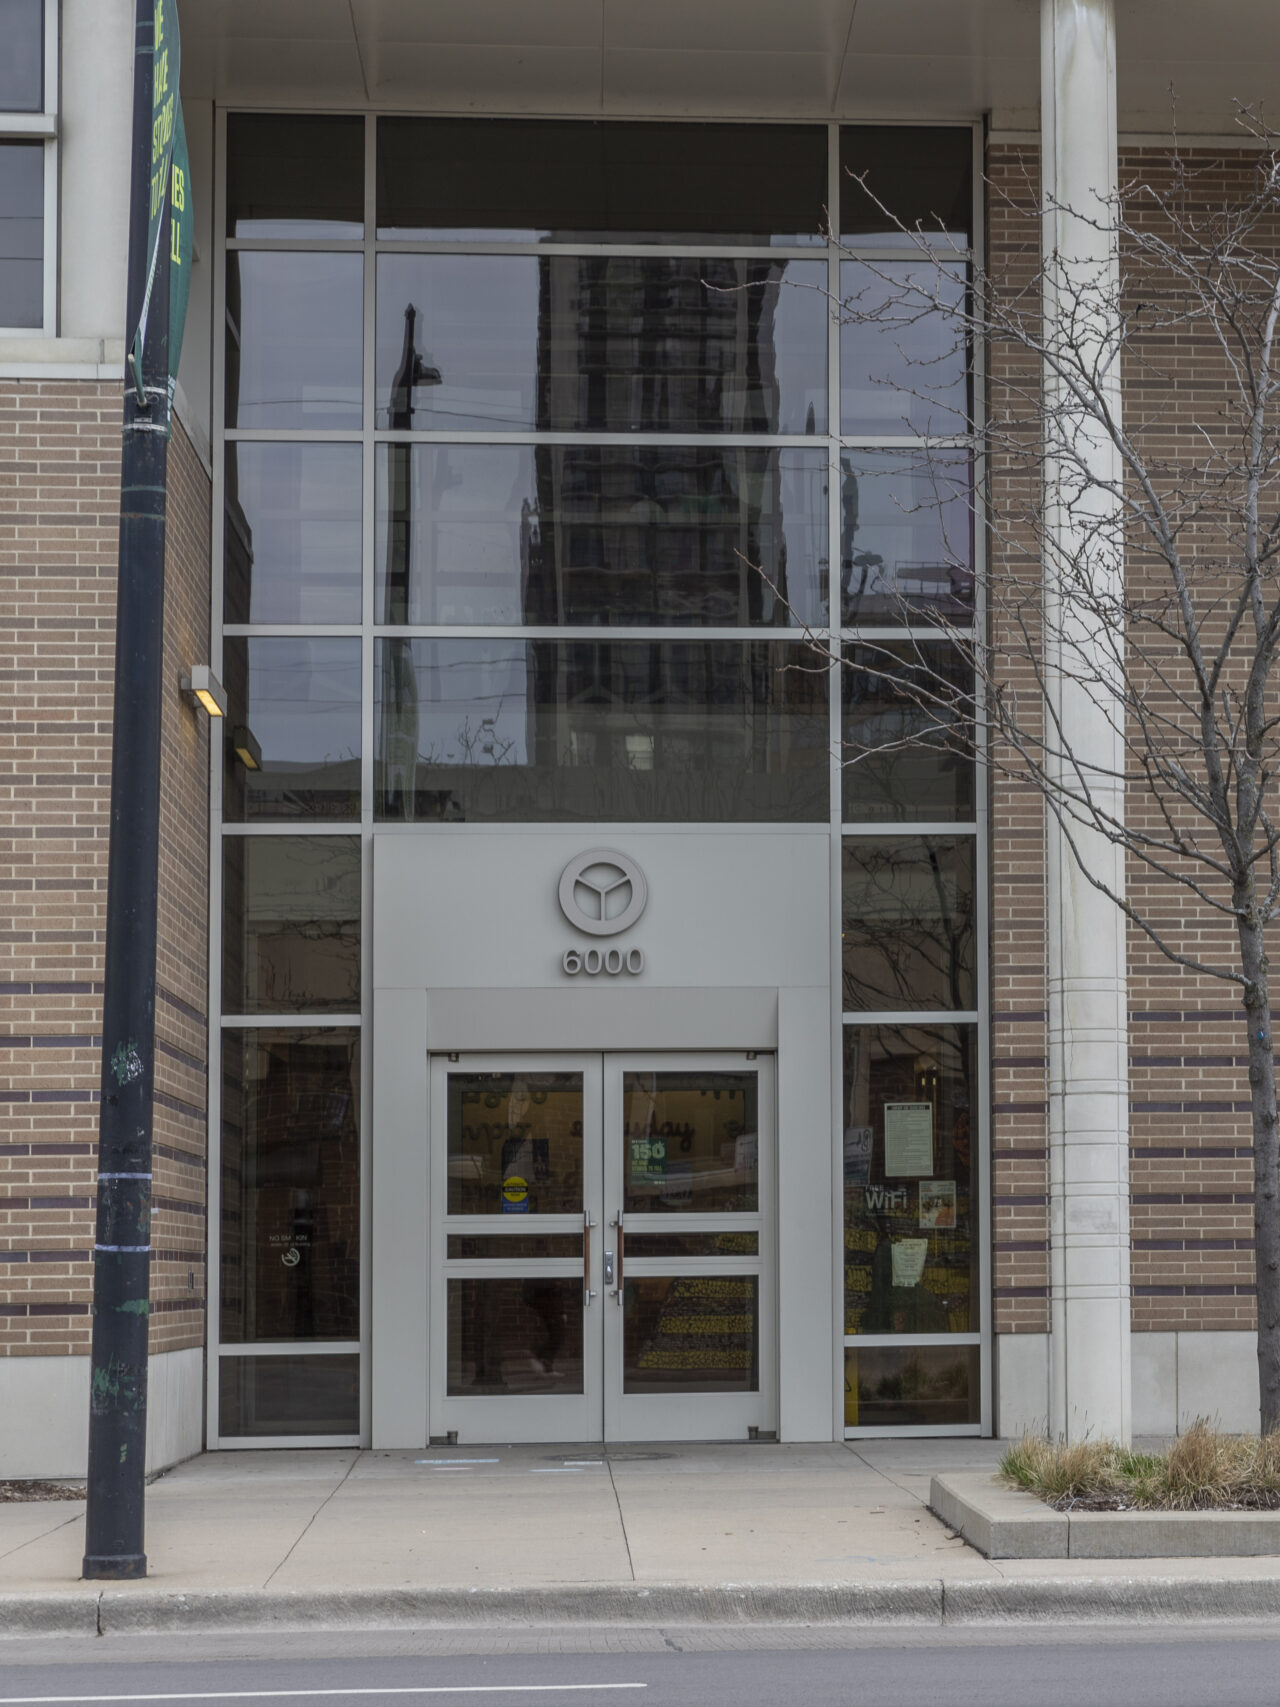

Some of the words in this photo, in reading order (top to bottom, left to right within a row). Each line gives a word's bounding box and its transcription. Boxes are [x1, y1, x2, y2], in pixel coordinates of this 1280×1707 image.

[562, 946, 645, 976] 6000
[631, 1140, 665, 1160] 150
[865, 1191, 908, 1209] WiFi
